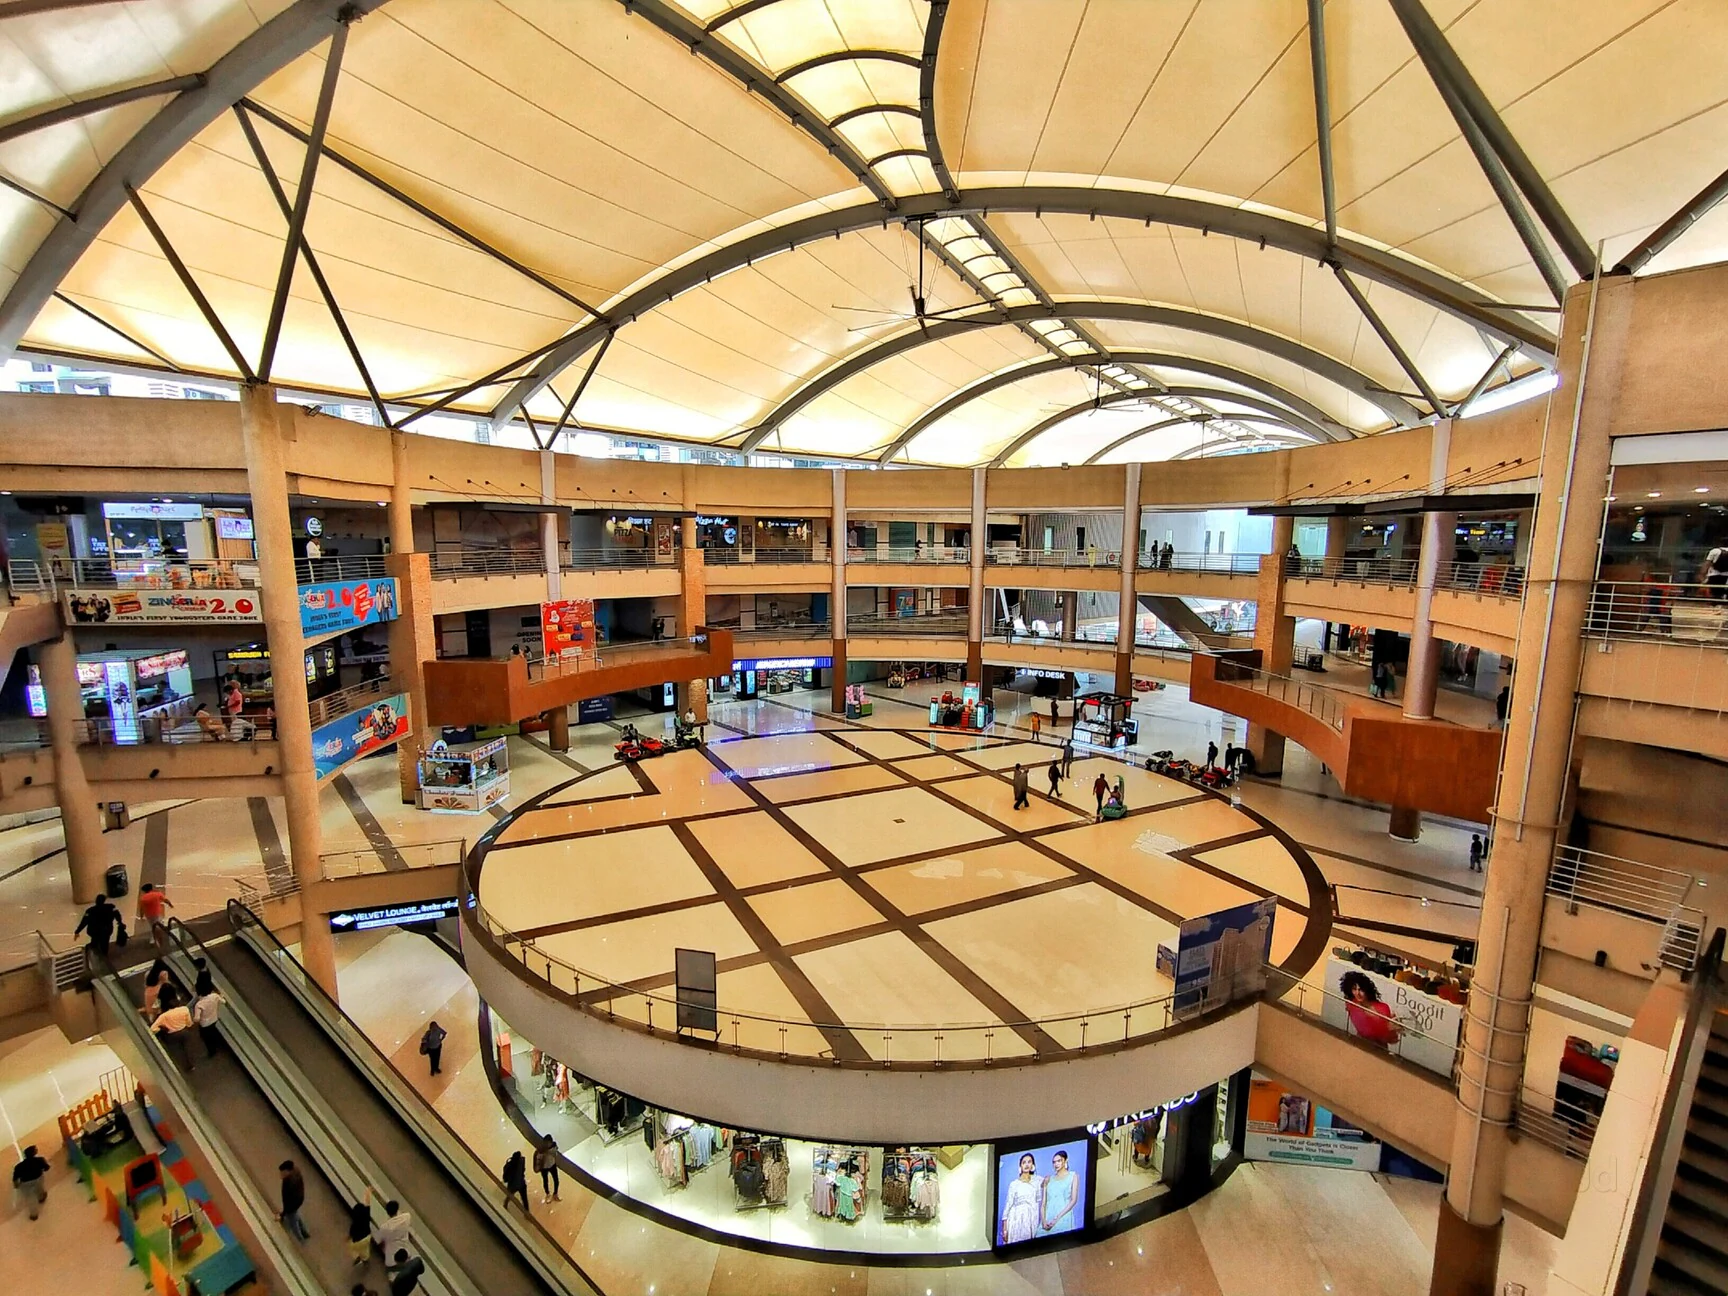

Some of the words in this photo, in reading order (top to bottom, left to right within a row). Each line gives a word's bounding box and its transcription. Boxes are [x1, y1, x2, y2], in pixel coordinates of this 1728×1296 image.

[614, 529, 633, 537] PIZZA
[209, 597, 254, 614] 2.0
[326, 587, 353, 610] 2.0
[1027, 669, 1045, 677] INFO
[1045, 671, 1065, 680] DESK
[354, 910, 385, 921] VELVET
[1395, 986, 1445, 1031] Baggit
